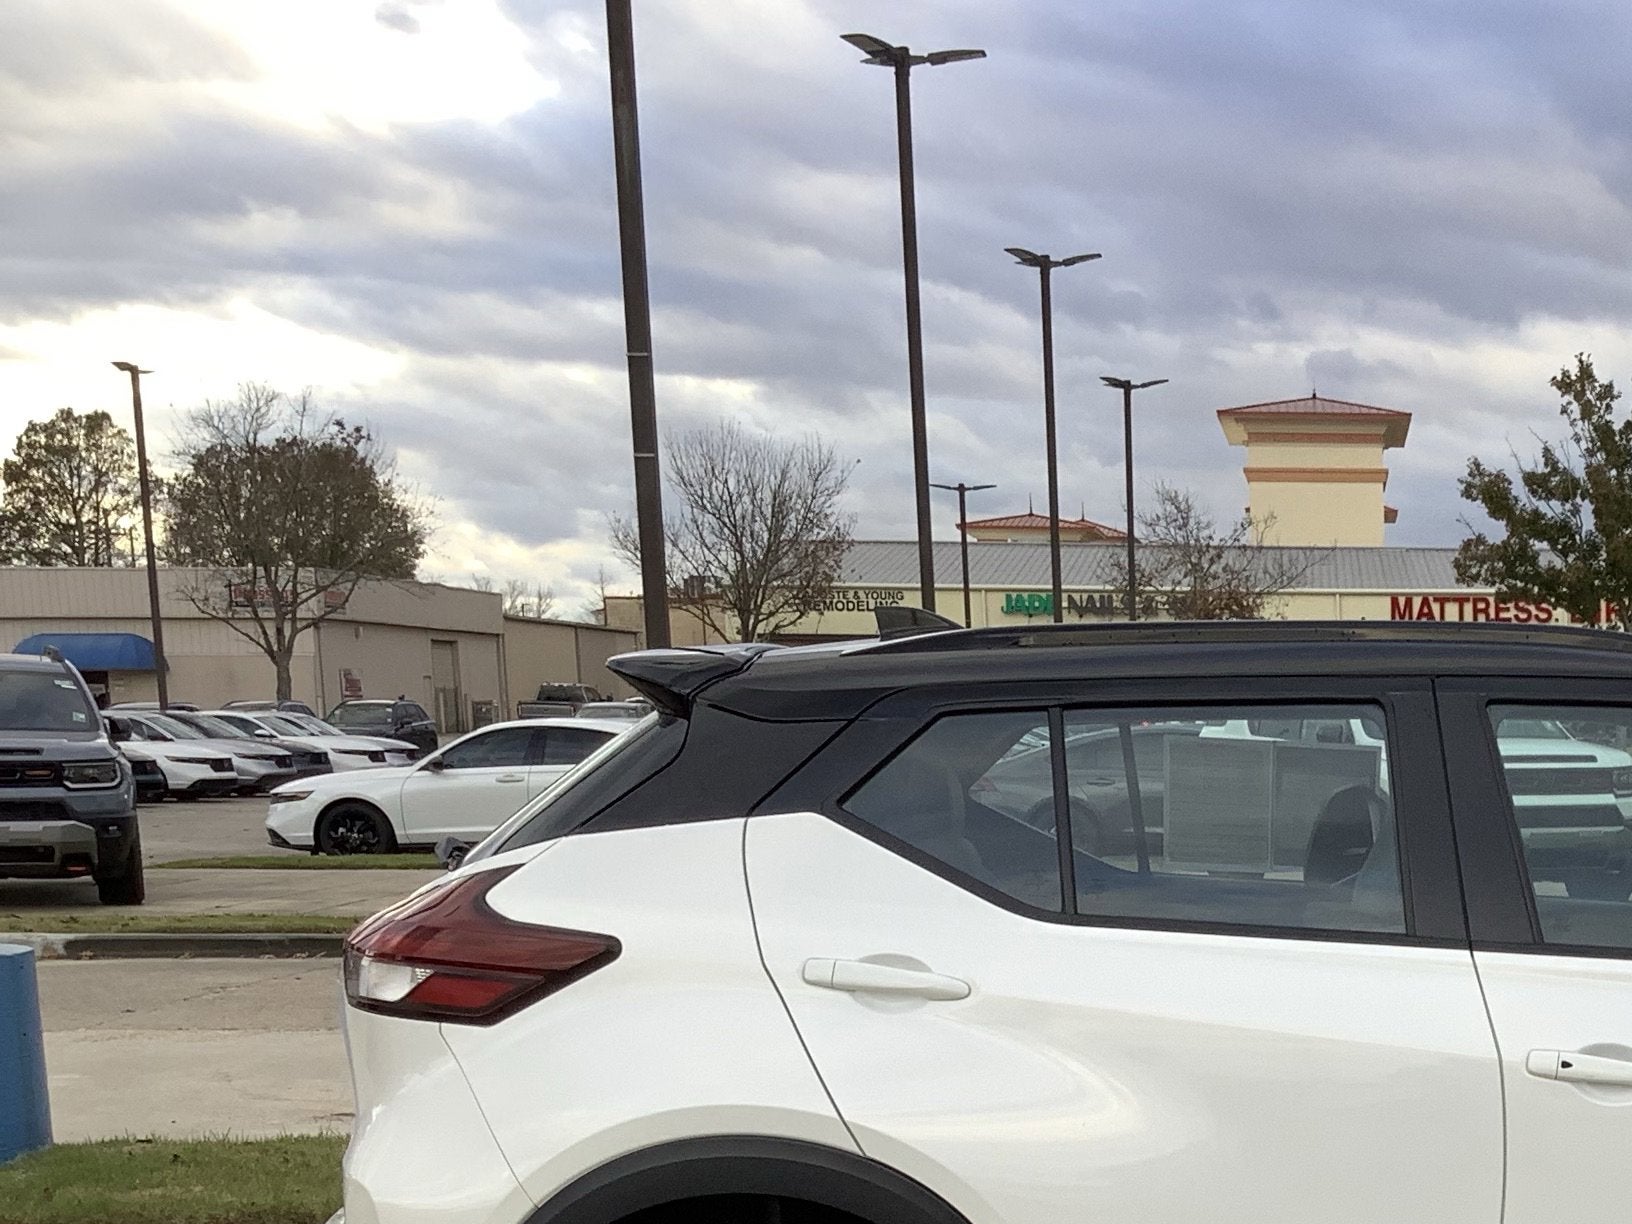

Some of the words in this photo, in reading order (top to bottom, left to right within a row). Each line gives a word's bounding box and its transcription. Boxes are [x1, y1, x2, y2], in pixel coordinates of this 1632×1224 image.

[853, 591, 861, 600] &
[864, 591, 904, 600] YOUNG
[1389, 595, 1553, 623] MATTRESS
